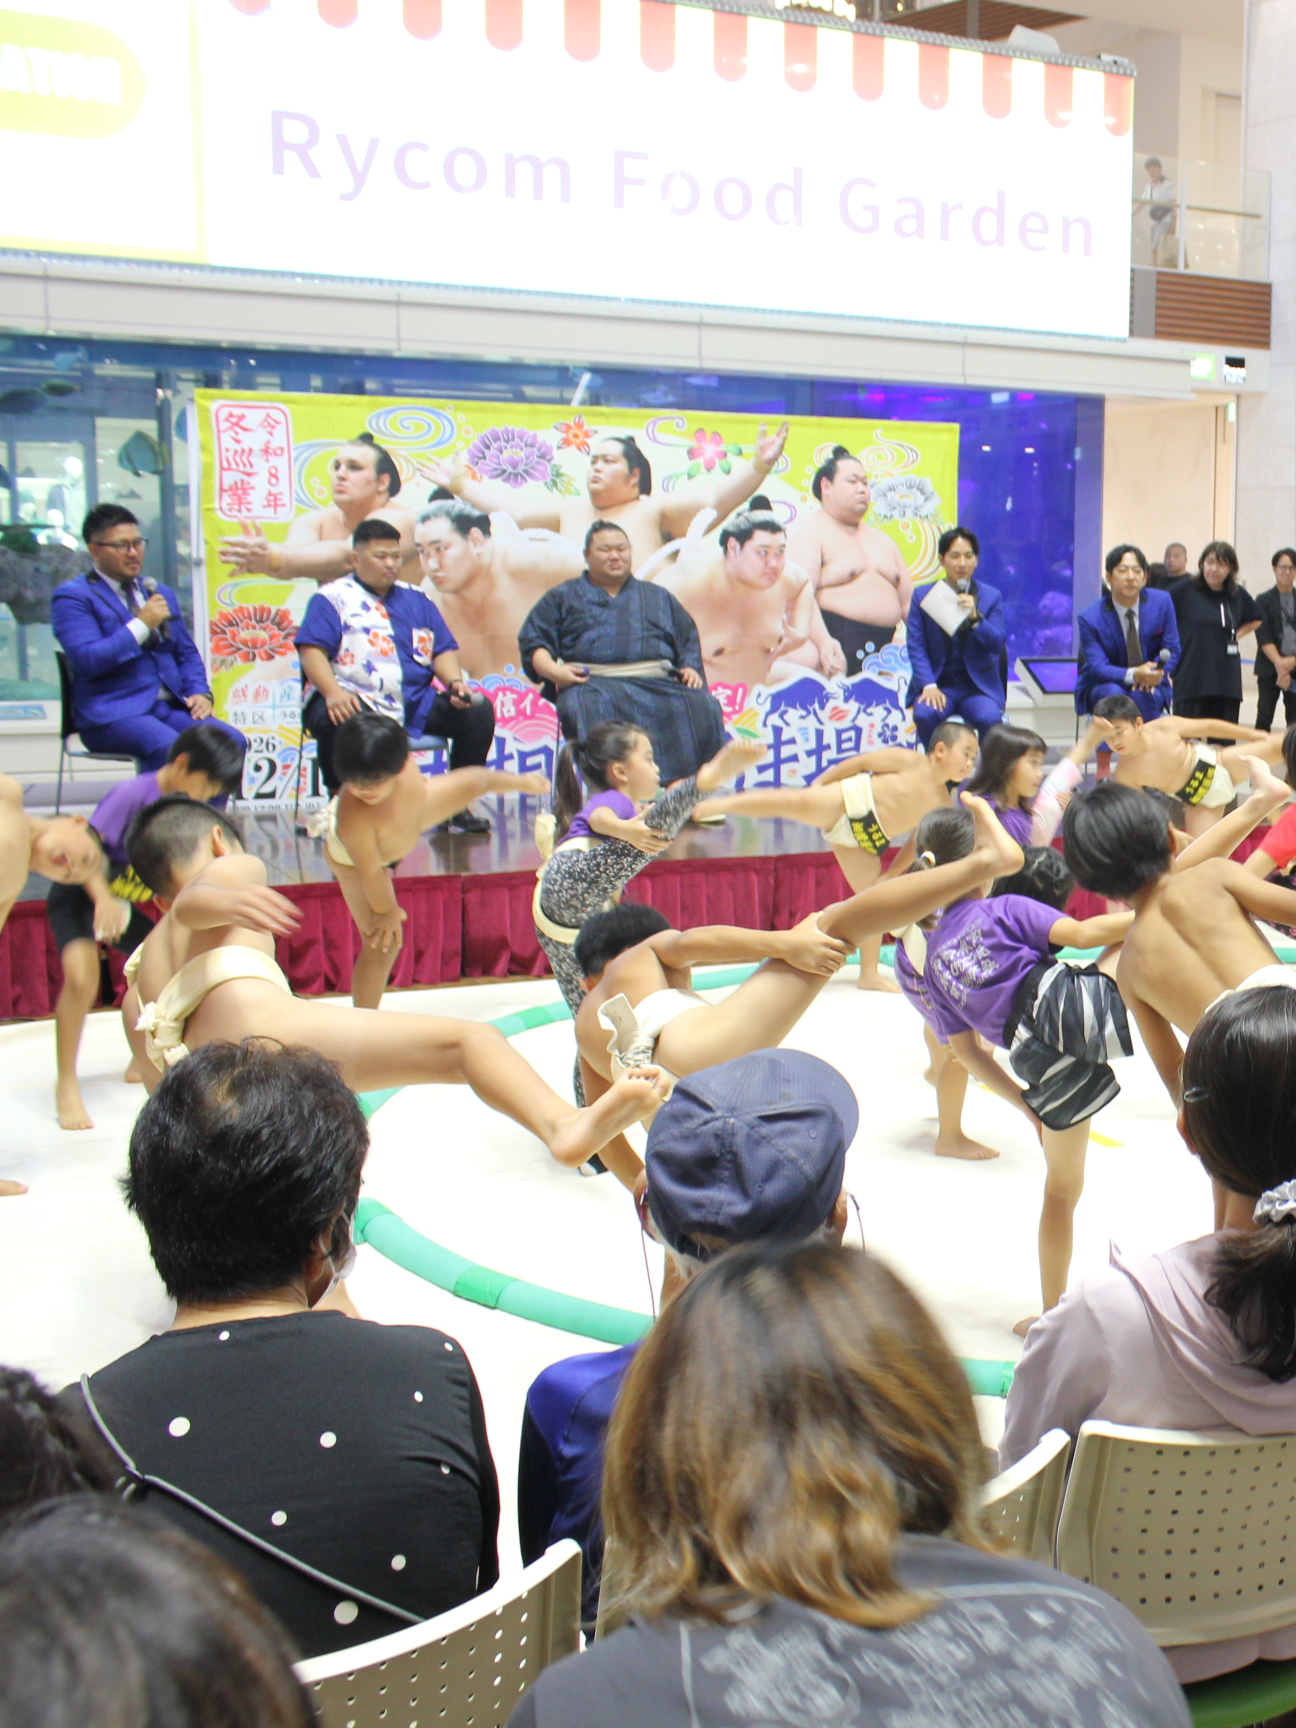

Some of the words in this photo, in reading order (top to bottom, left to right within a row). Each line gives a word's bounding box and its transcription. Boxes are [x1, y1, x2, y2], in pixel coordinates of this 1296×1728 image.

[0, 44, 122, 104] ATION
[270, 109, 572, 204] Rycom
[613, 149, 803, 226] Food
[839, 176, 1093, 256] Garden
[220, 410, 258, 514] 冬巡業
[258, 411, 287, 515] 令和8年
